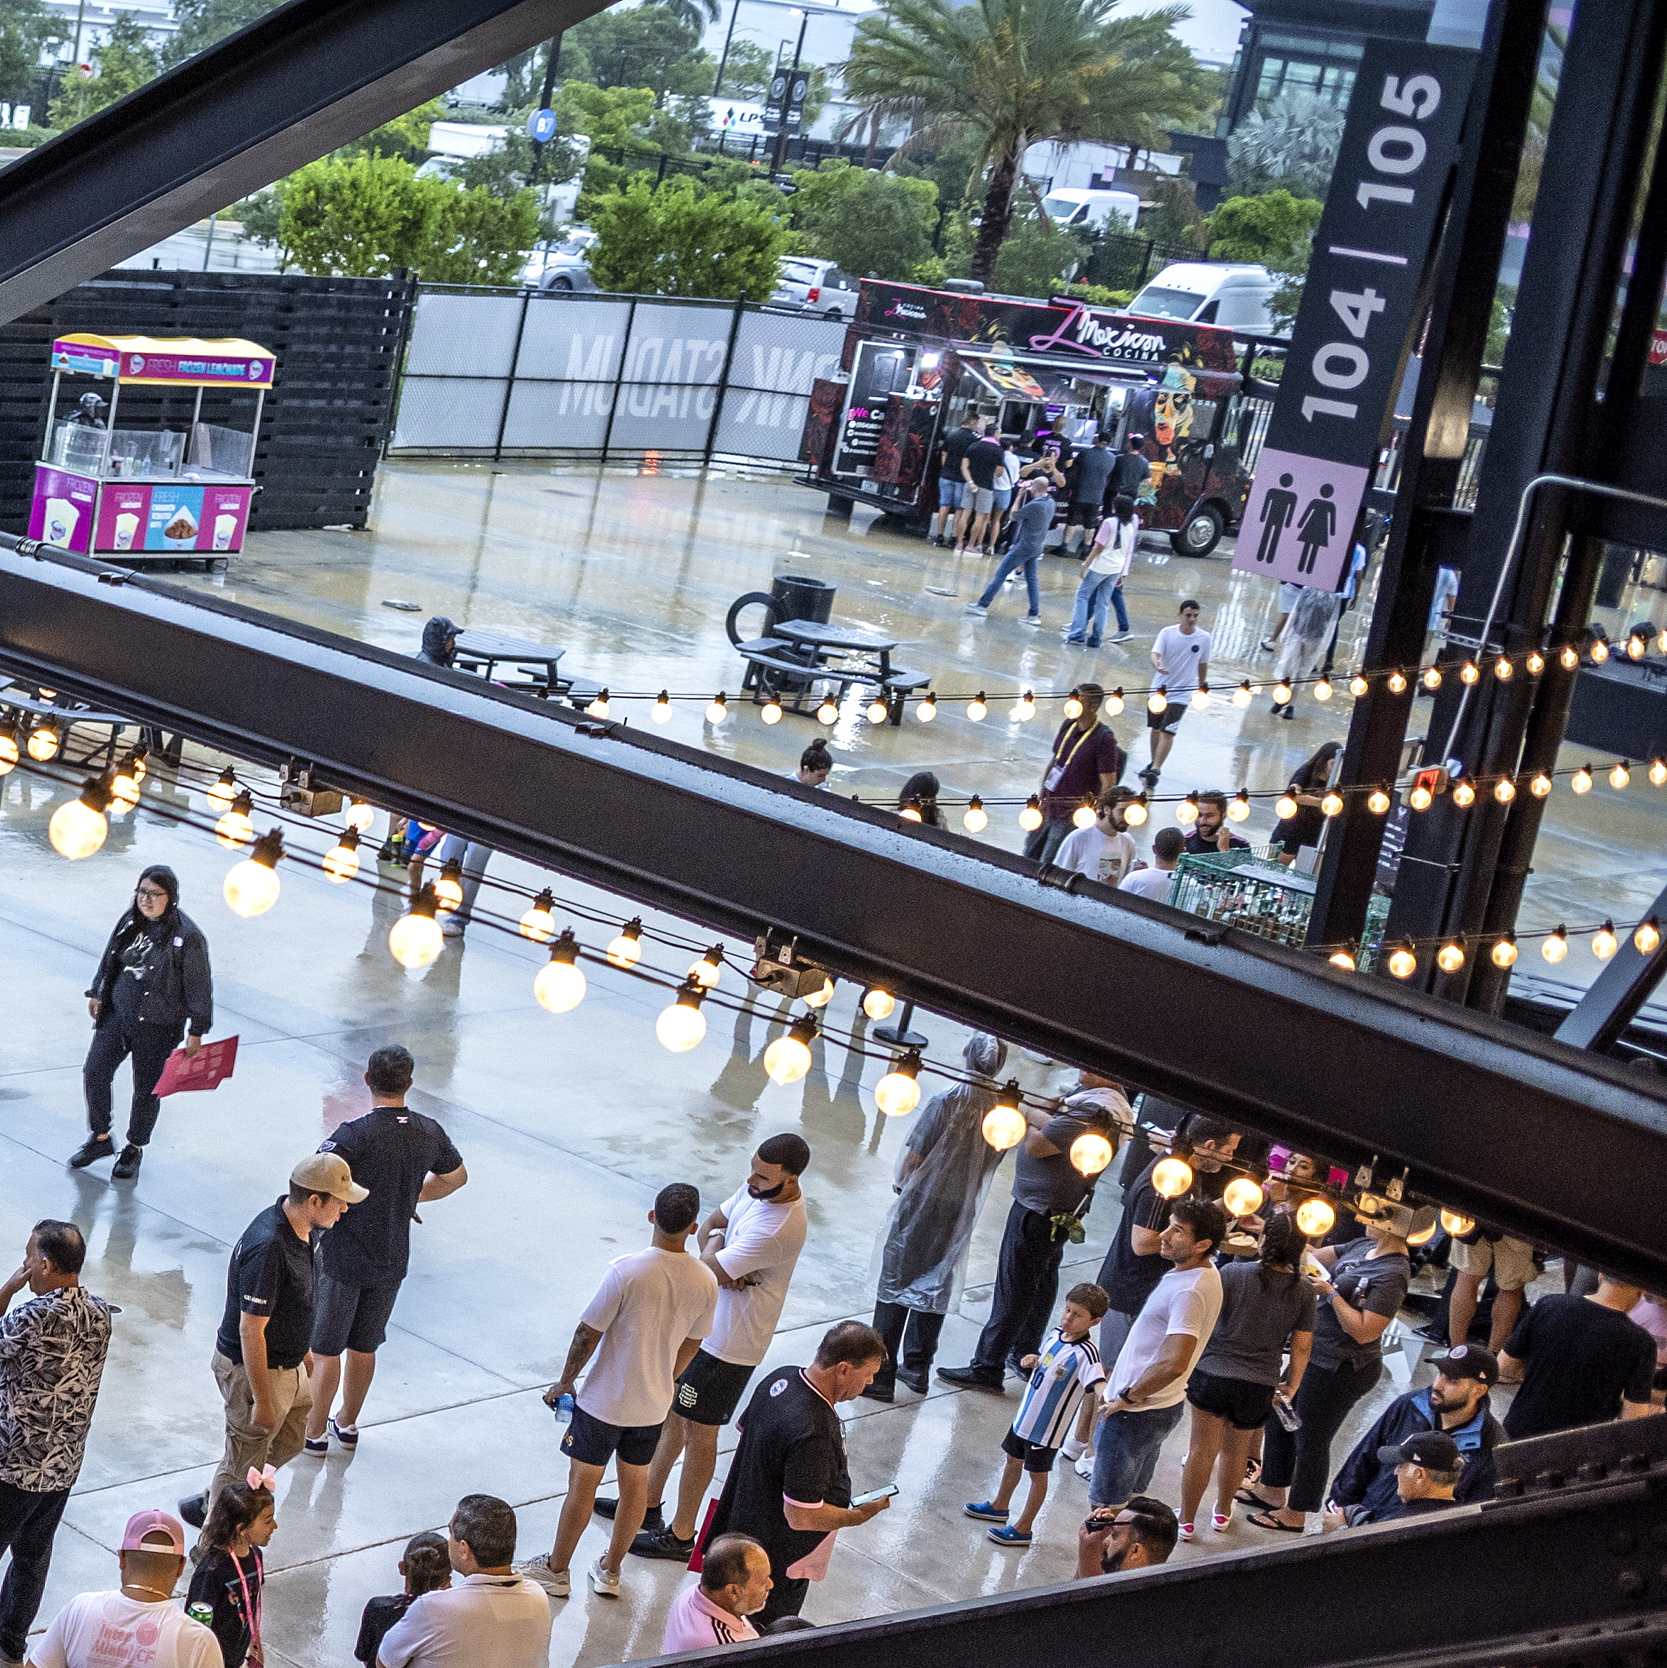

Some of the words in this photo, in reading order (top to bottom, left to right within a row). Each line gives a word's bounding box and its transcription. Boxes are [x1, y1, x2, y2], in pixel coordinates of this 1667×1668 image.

[537, 117, 555, 134] B7
[1355, 73, 1442, 210] 105
[1102, 346, 1161, 362] COCINA
[1300, 287, 1387, 422] 104
